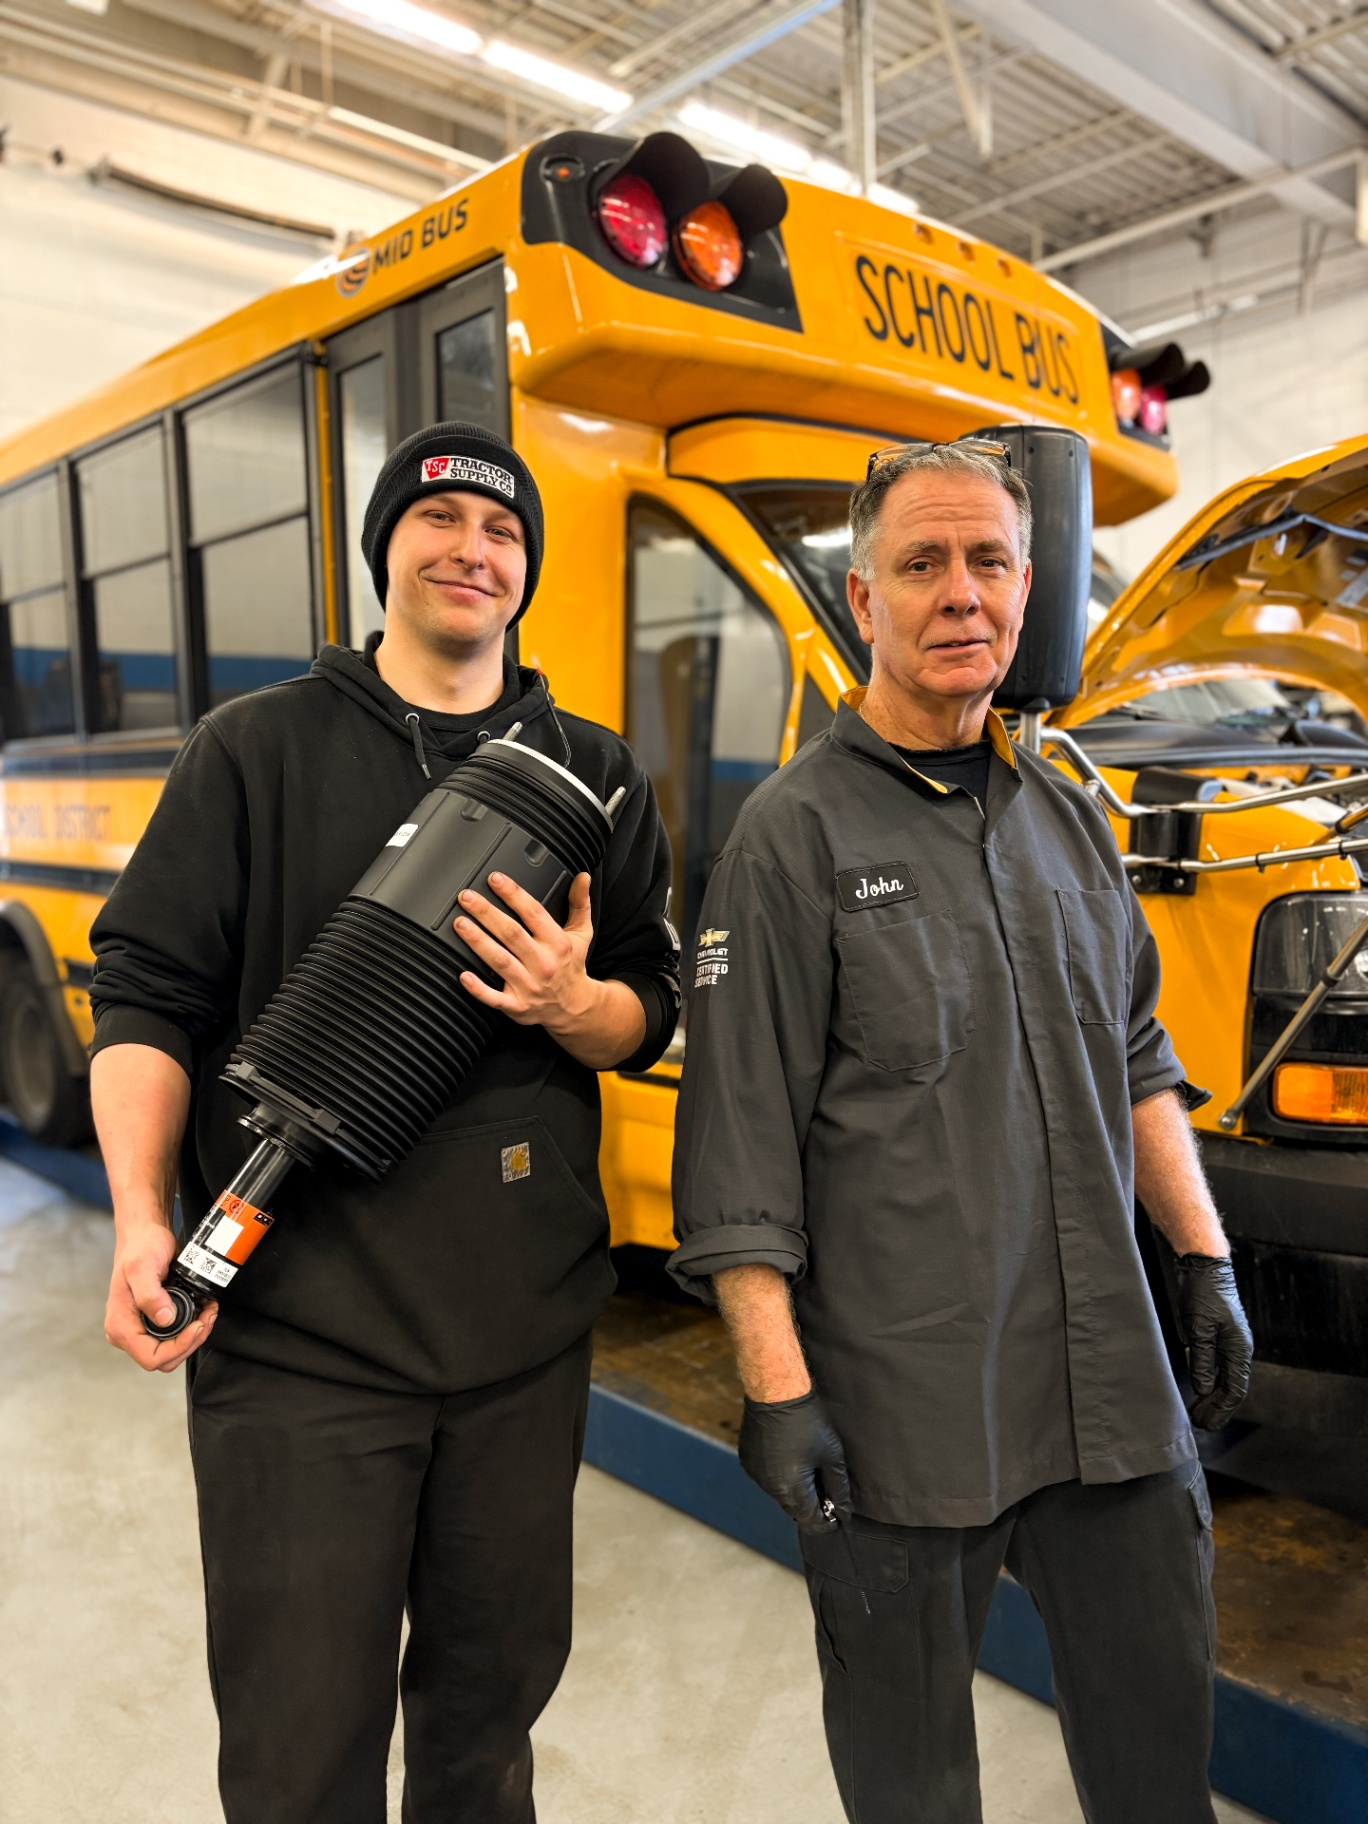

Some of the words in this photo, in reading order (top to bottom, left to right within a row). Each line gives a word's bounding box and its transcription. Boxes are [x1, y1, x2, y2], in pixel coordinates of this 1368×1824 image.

[372, 229, 414, 275] MID
[421, 197, 470, 249] BUS
[855, 255, 1015, 382] SCHOOL
[1014, 310, 1079, 405] BUS
[424, 460, 446, 474] TSC
[450, 457, 514, 485] TRACTOR
[450, 468, 498, 487] SUPPLY
[855, 876, 904, 899] John
